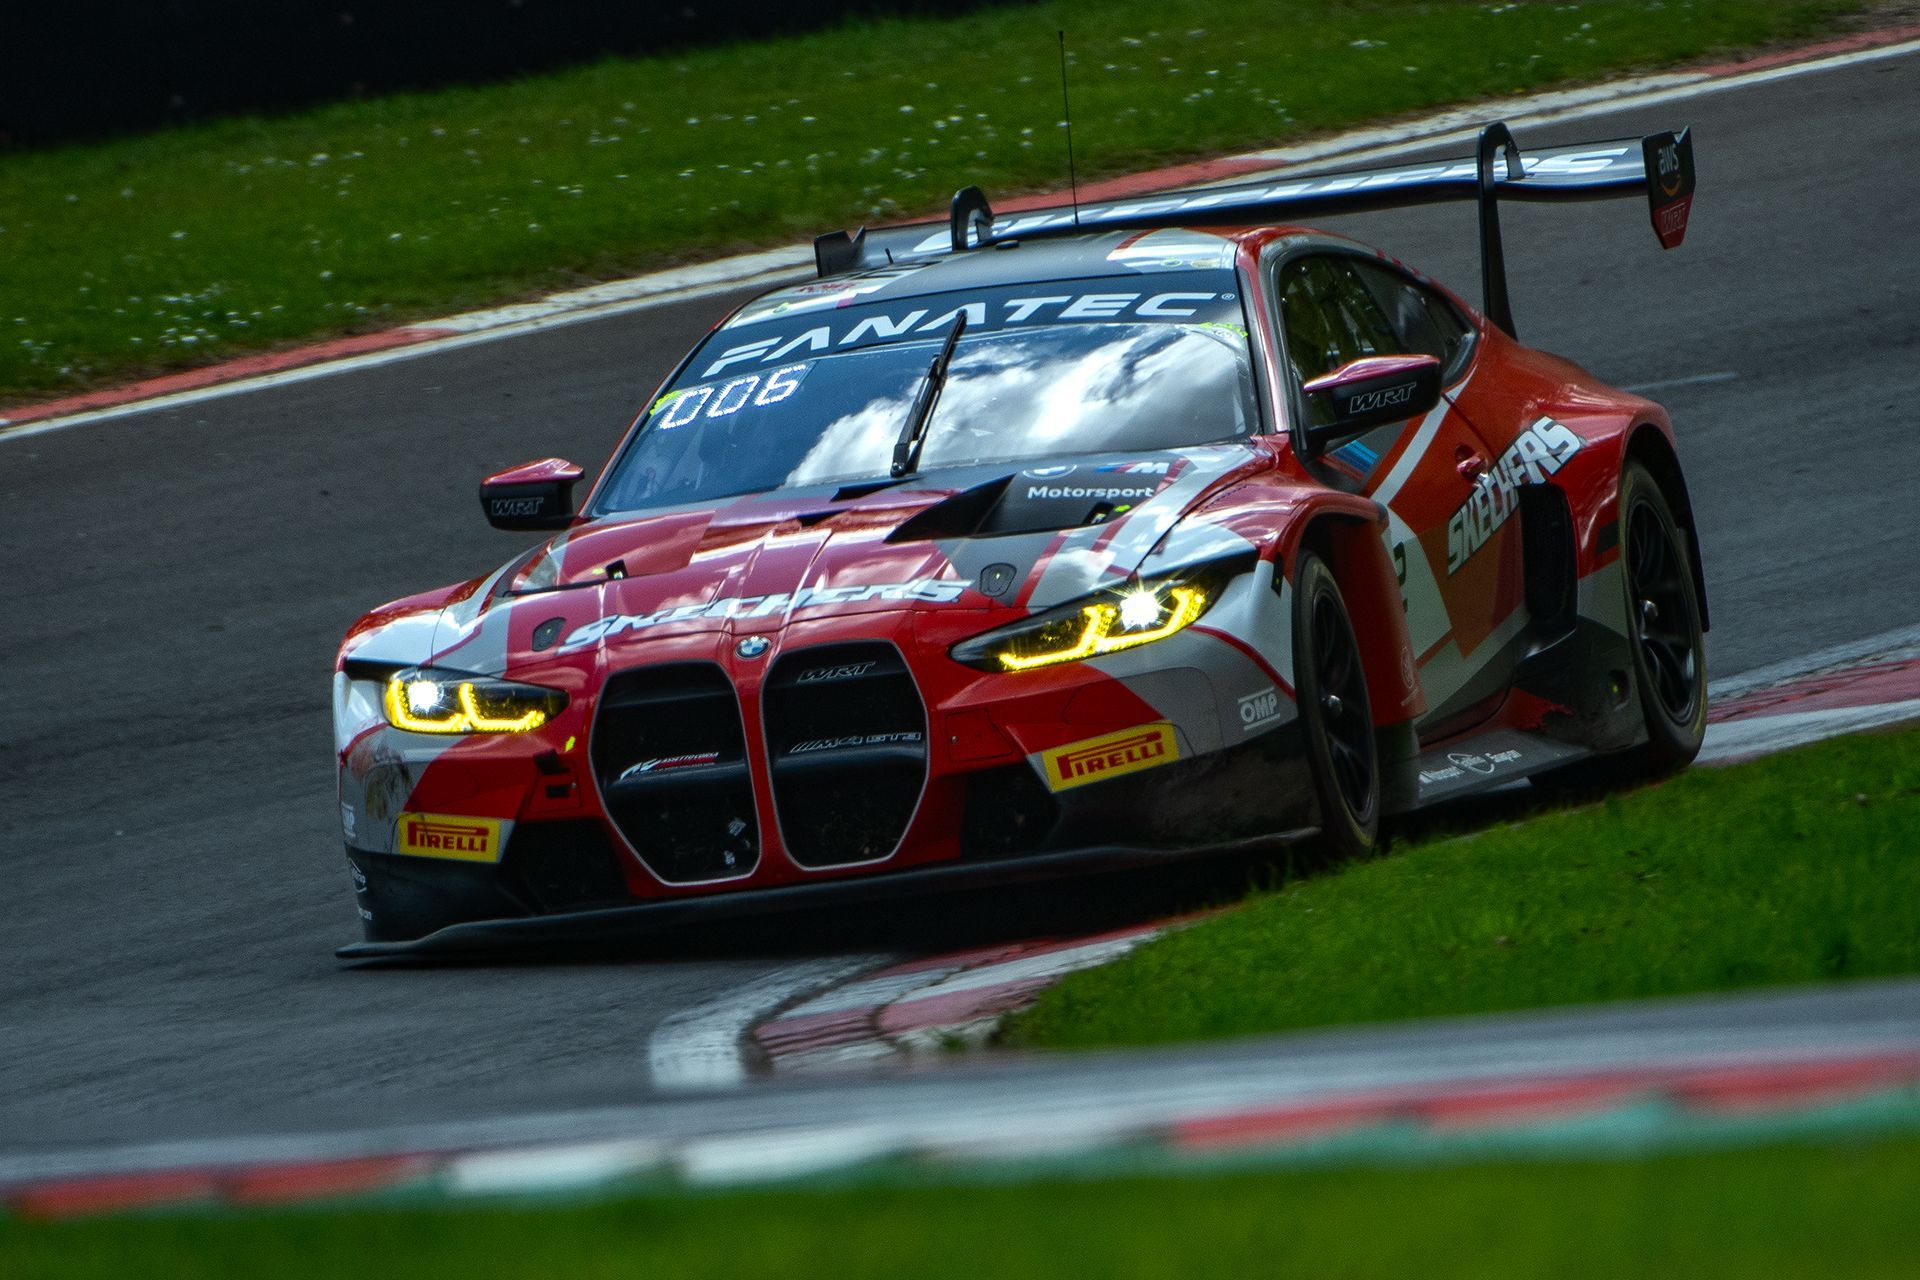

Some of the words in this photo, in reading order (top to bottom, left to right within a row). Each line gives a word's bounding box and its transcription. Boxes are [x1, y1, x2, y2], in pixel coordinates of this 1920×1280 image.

[1658, 143, 1680, 175] aws
[658, 364, 807, 430] 006
[1349, 381, 1417, 414] WRT
[491, 496, 545, 516] WRT
[1028, 486, 1155, 499] Motorsport
[1447, 416, 1582, 577] SKECHERS
[796, 660, 877, 685] WRT
[1240, 691, 1278, 724] OMP
[1056, 731, 1166, 780] PIRELLI
[407, 821, 490, 853] PIRELLI
